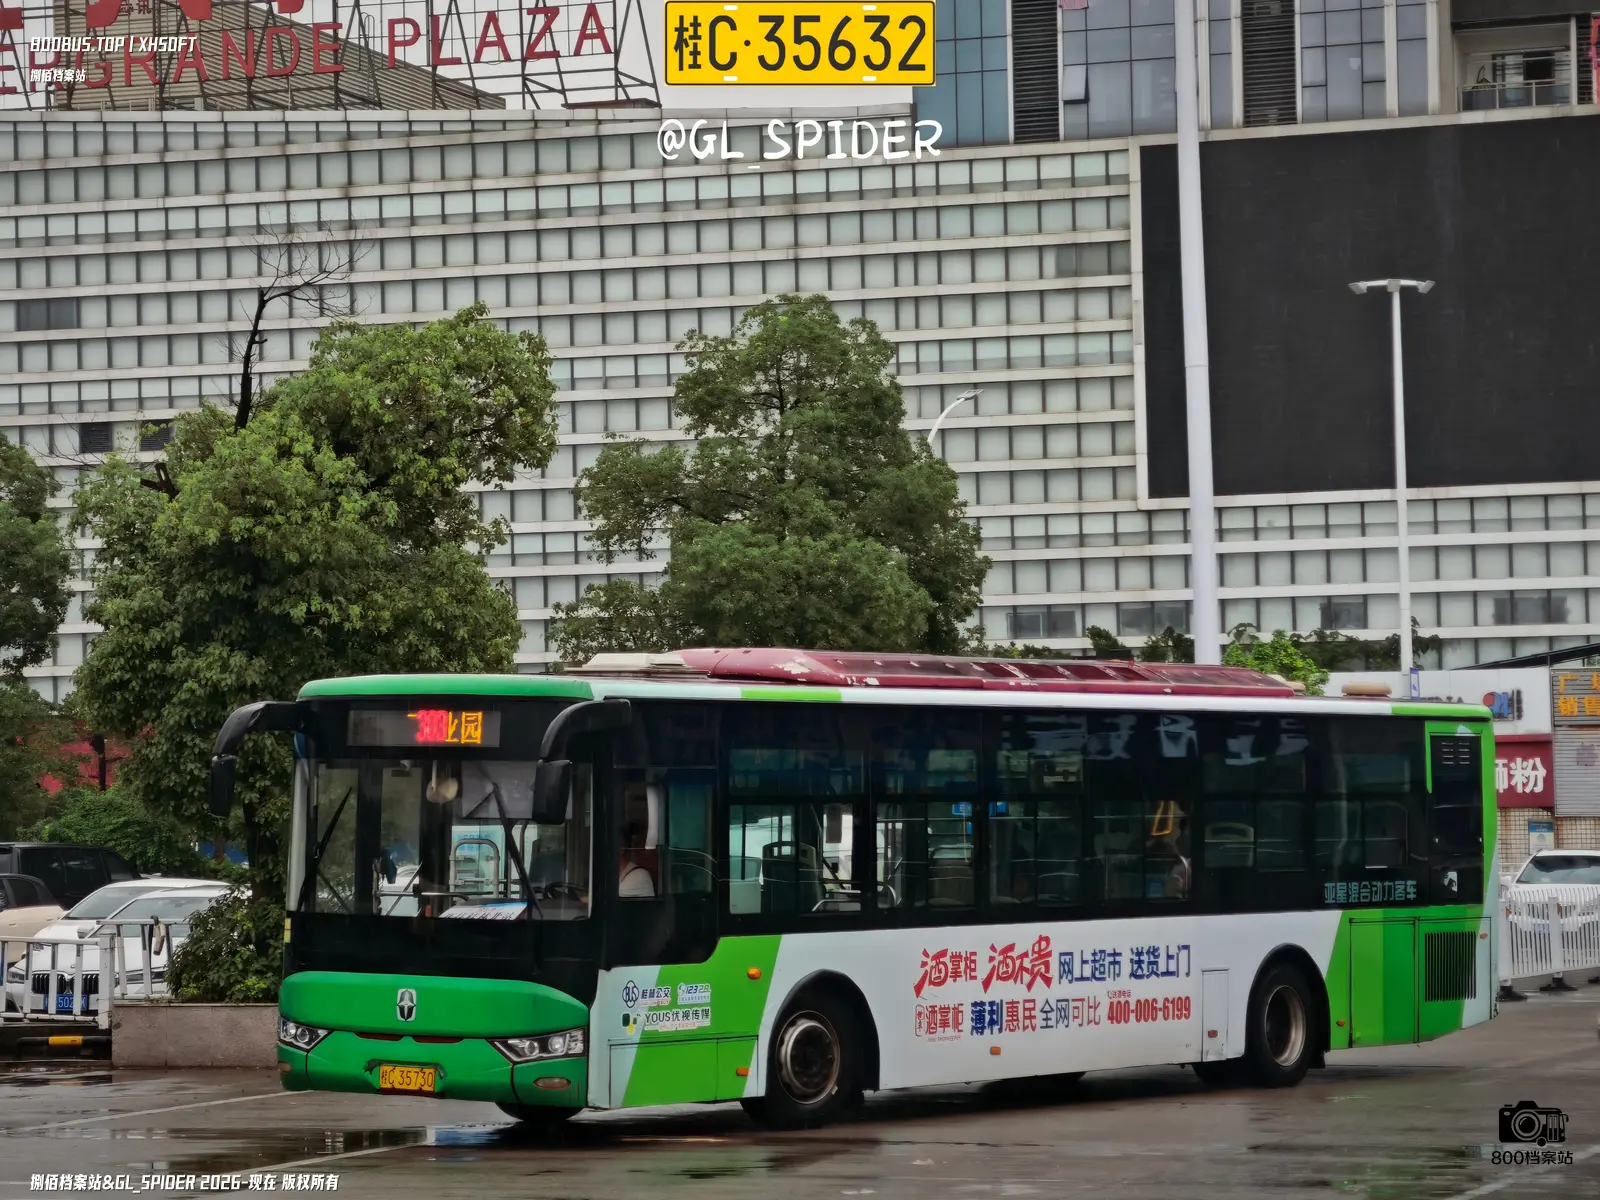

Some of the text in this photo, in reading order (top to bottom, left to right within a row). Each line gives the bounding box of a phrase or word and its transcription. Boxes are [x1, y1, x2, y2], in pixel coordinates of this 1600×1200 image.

[387, 2, 612, 70] PLAZA
[1324, 880, 1417, 904] 亚星混合动力客车
[913, 934, 1192, 999] 酒掌柜 酒不贵 网上超市 送货上门
[1107, 995, 1192, 1025] 400-006-6199
